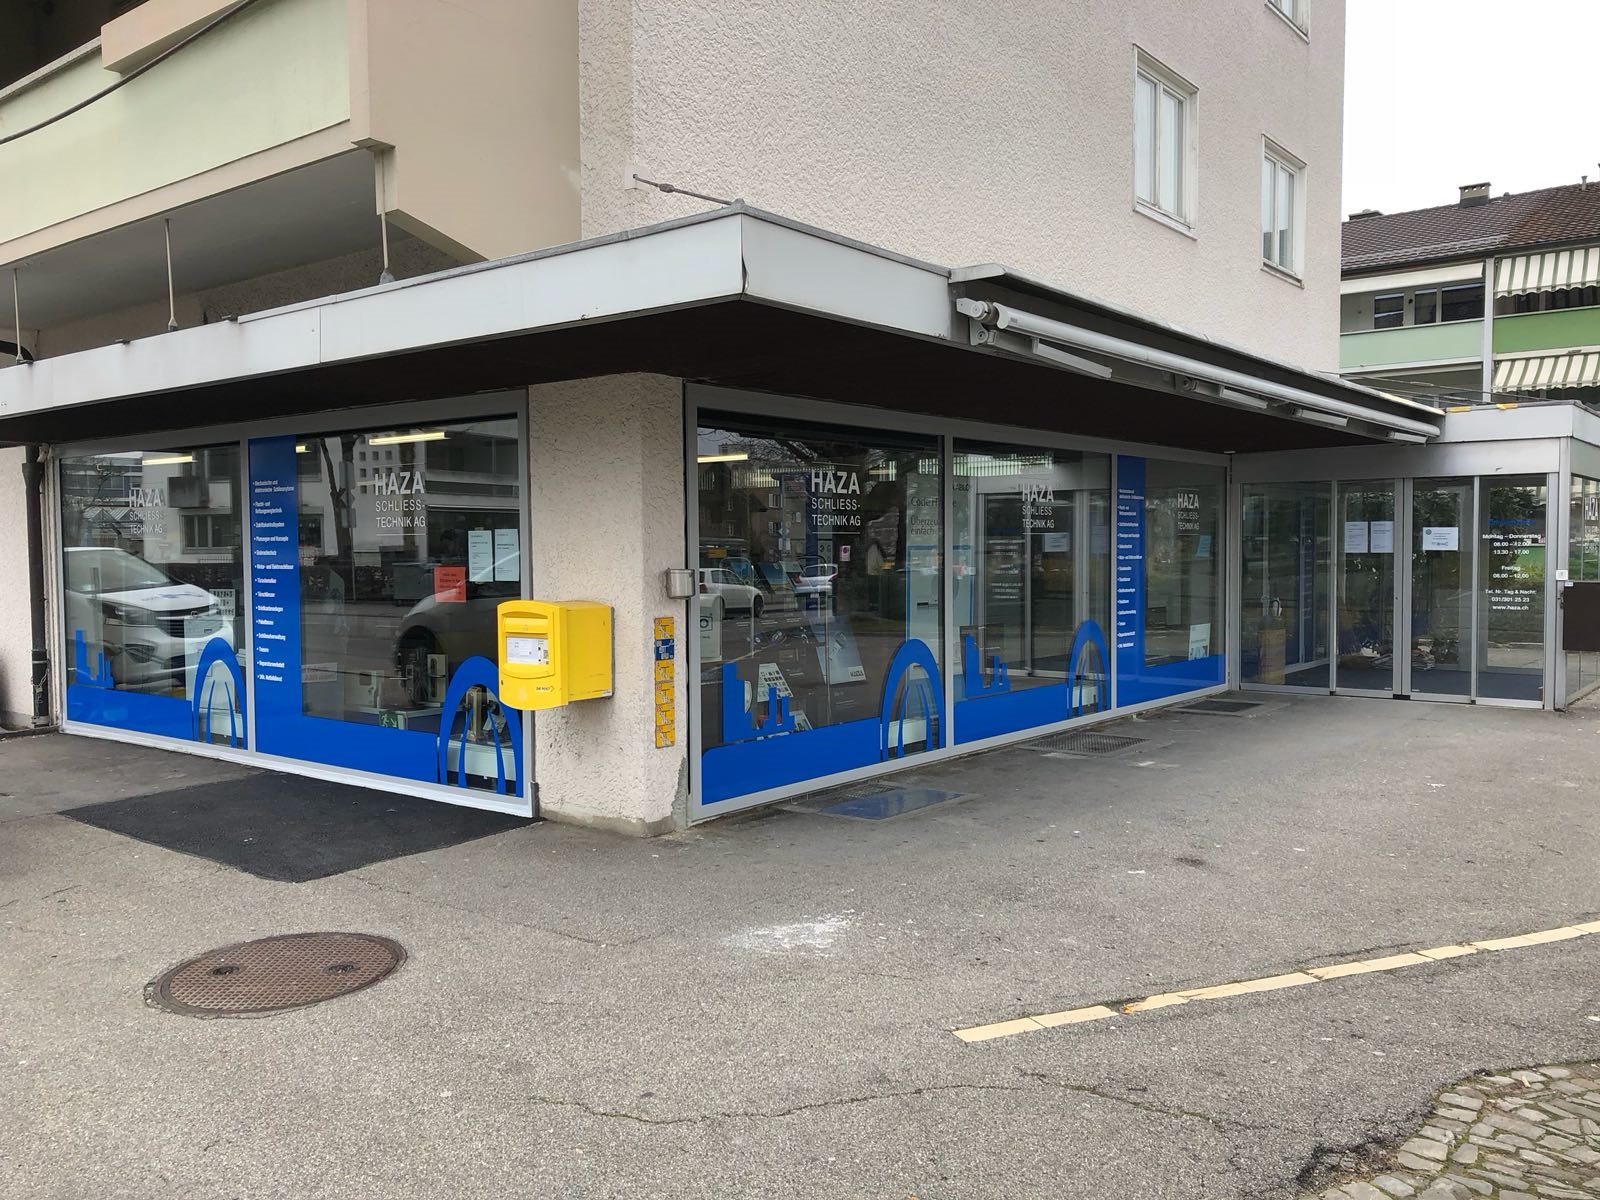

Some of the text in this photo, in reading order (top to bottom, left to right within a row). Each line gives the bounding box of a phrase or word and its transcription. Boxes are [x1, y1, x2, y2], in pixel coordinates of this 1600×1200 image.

[375, 471, 425, 496] HAZA
[811, 469, 861, 495] HAZA
[128, 488, 161, 508] HAZA
[1022, 483, 1055, 502] HAZA
[375, 499, 426, 512] SCHLIESS-
[811, 497, 861, 510] SCHLIESS-
[1177, 492, 1200, 509] HAZA
[375, 515, 426, 528] TECHNIK AG
[811, 514, 861, 527] TECHNIK AG
[1046, 519, 1055, 529] AG
